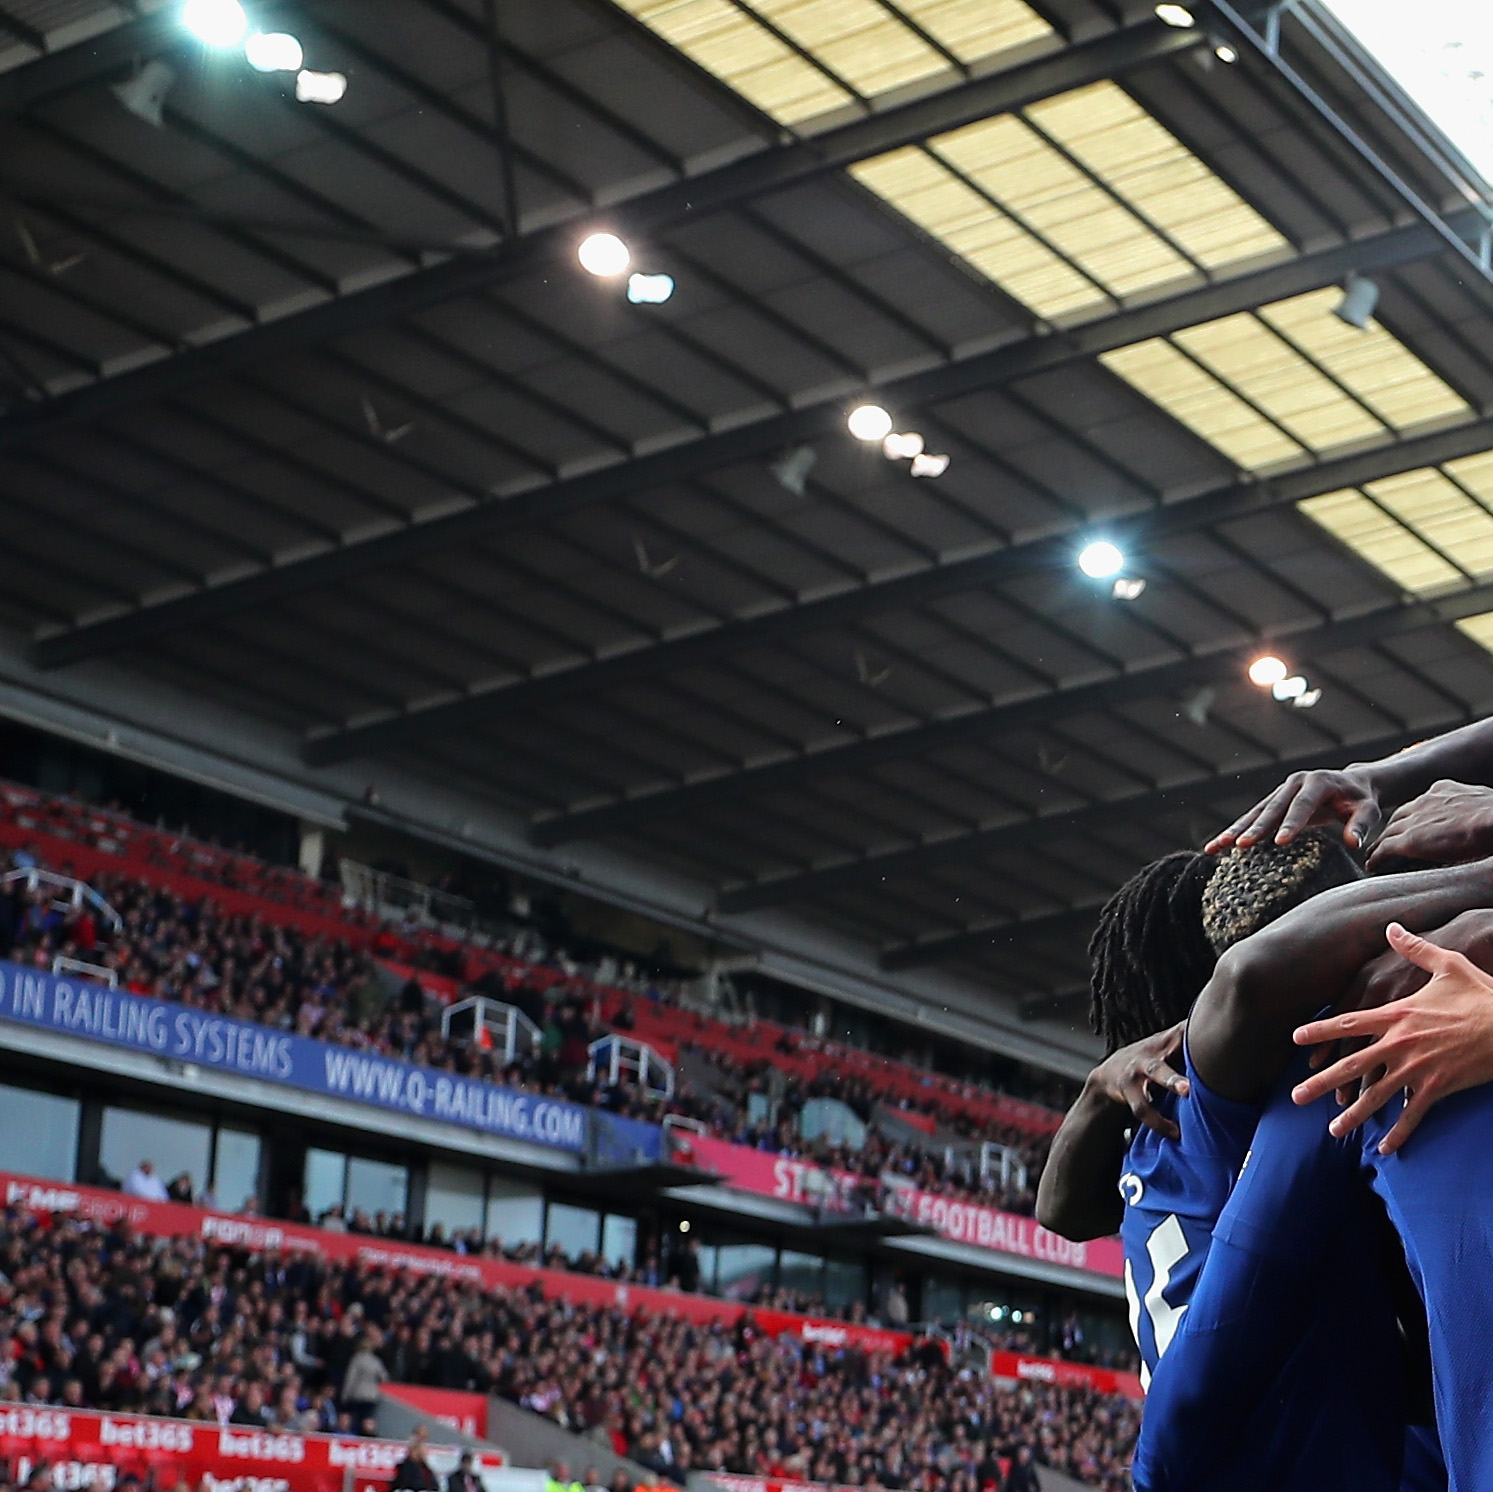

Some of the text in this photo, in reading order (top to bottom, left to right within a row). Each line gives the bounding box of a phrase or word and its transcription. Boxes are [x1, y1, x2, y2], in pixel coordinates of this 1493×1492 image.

[13, 971, 45, 1019] IN
[54, 982, 168, 1050] RAILING
[175, 1012, 293, 1079] SYSTEMS
[325, 1049, 583, 1146] WWW.Q-RAILING.COM
[918, 1198, 1030, 1257] FOOTBALL
[101, 1415, 194, 1452] bet365
[219, 1428, 305, 1462] bet365
